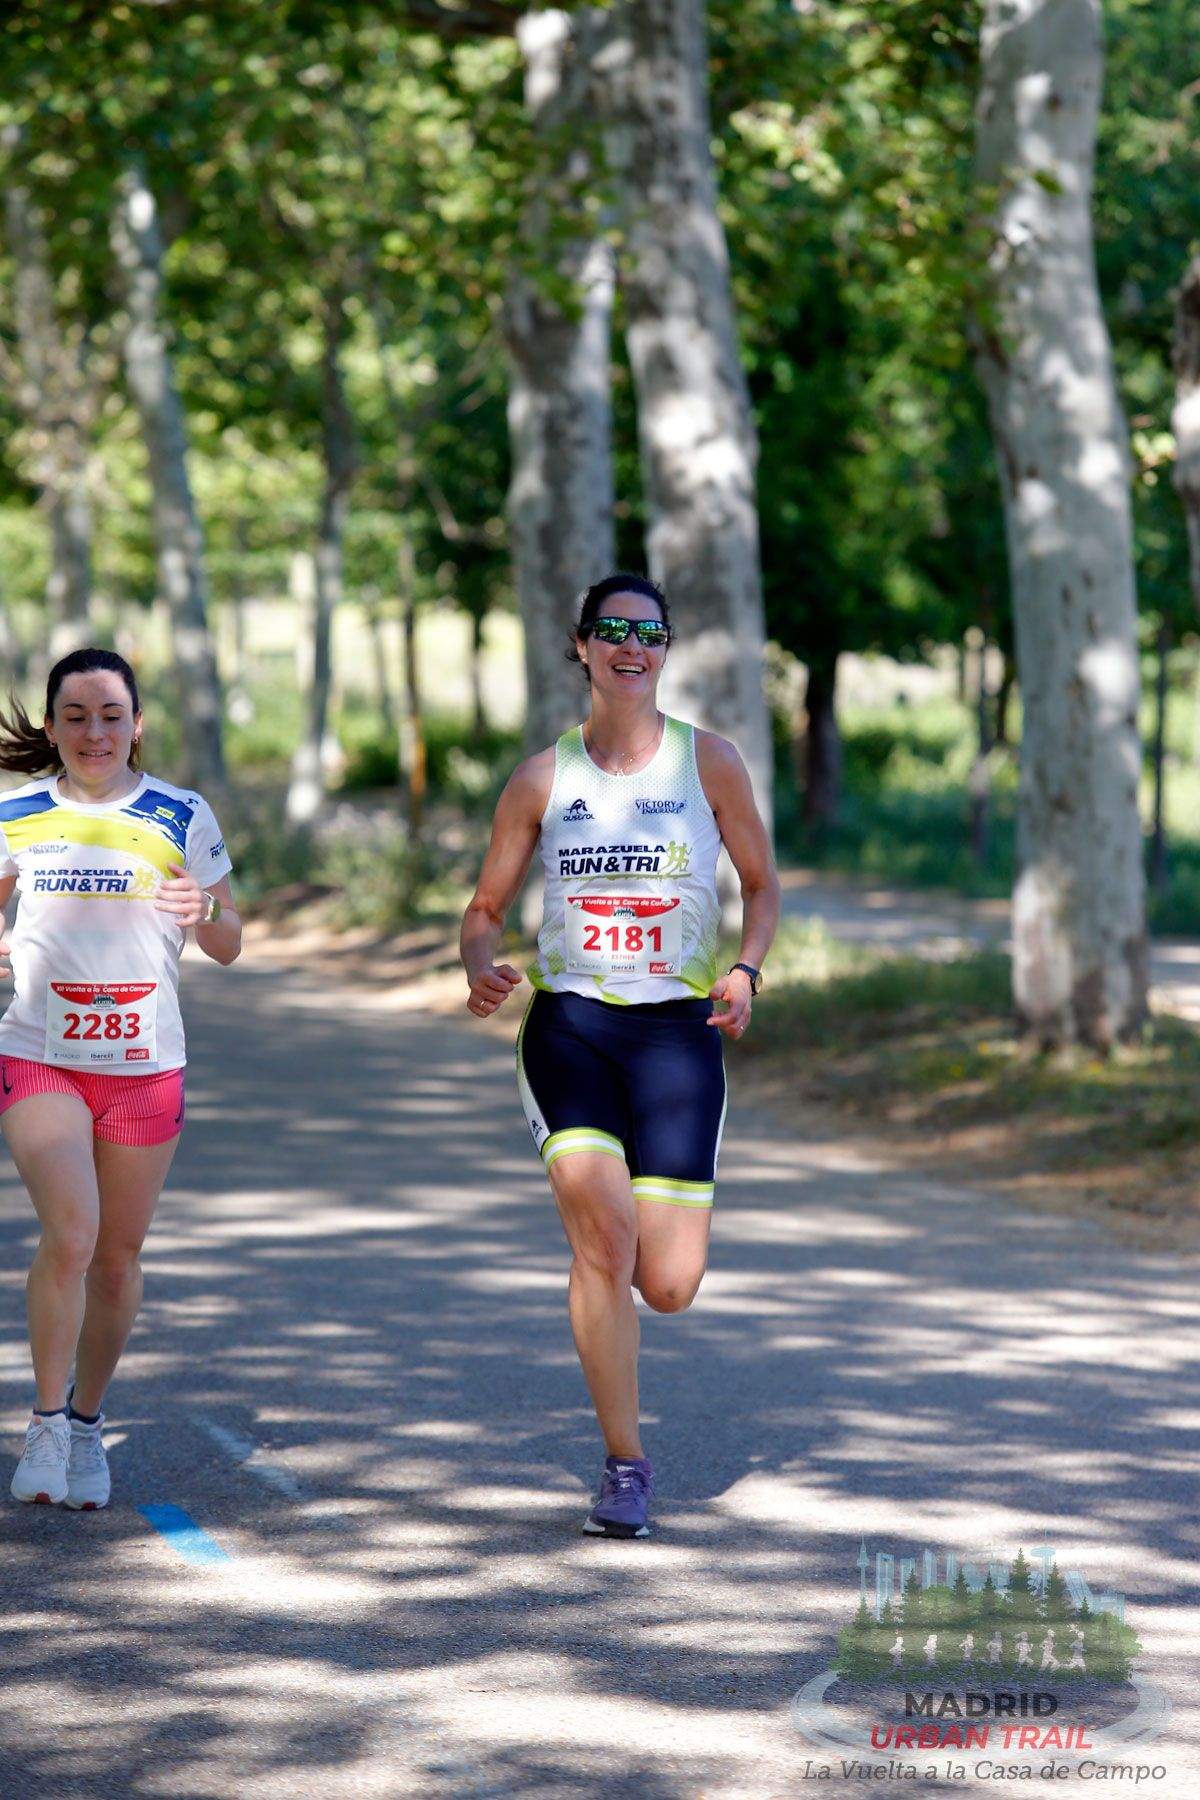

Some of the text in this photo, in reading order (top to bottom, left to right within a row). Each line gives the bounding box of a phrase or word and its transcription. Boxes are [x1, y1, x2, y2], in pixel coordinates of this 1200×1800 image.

[635, 800, 677, 809] VICTORY
[558, 845, 666, 857] MARAZUELA
[583, 925, 661, 952] 2181
[129, 985, 151, 994] Campo
[63, 1013, 140, 1040] 2283
